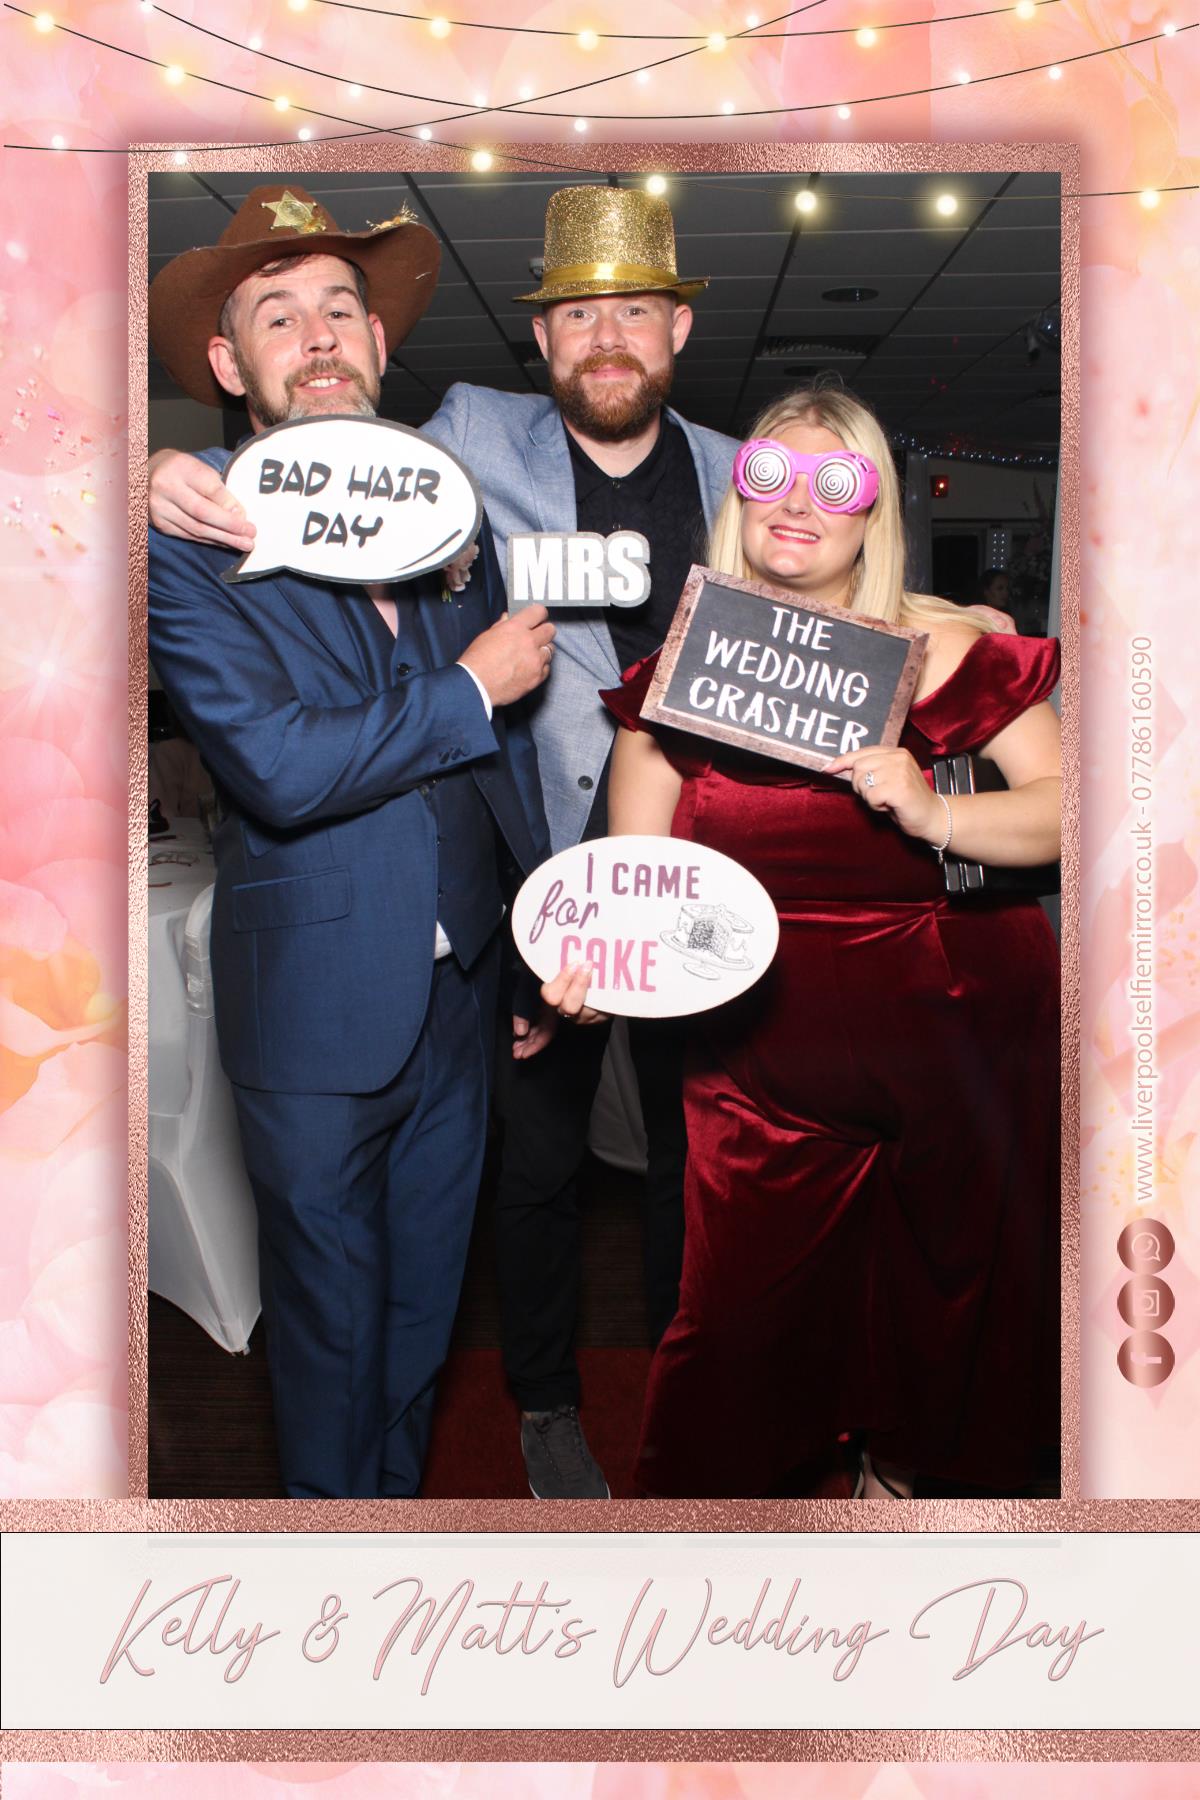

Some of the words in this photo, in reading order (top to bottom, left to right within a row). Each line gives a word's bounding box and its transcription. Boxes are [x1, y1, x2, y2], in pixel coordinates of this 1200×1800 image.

[258, 458, 332, 497] BAD
[347, 464, 441, 505] HAIR
[302, 510, 384, 549] DAY
[512, 536, 645, 602] MRS
[771, 606, 834, 651] THE
[704, 630, 870, 708] WEDDING
[689, 676, 869, 754] CRASHER
[586, 852, 594, 894] I
[611, 862, 701, 900] CAME
[529, 879, 599, 944] for
